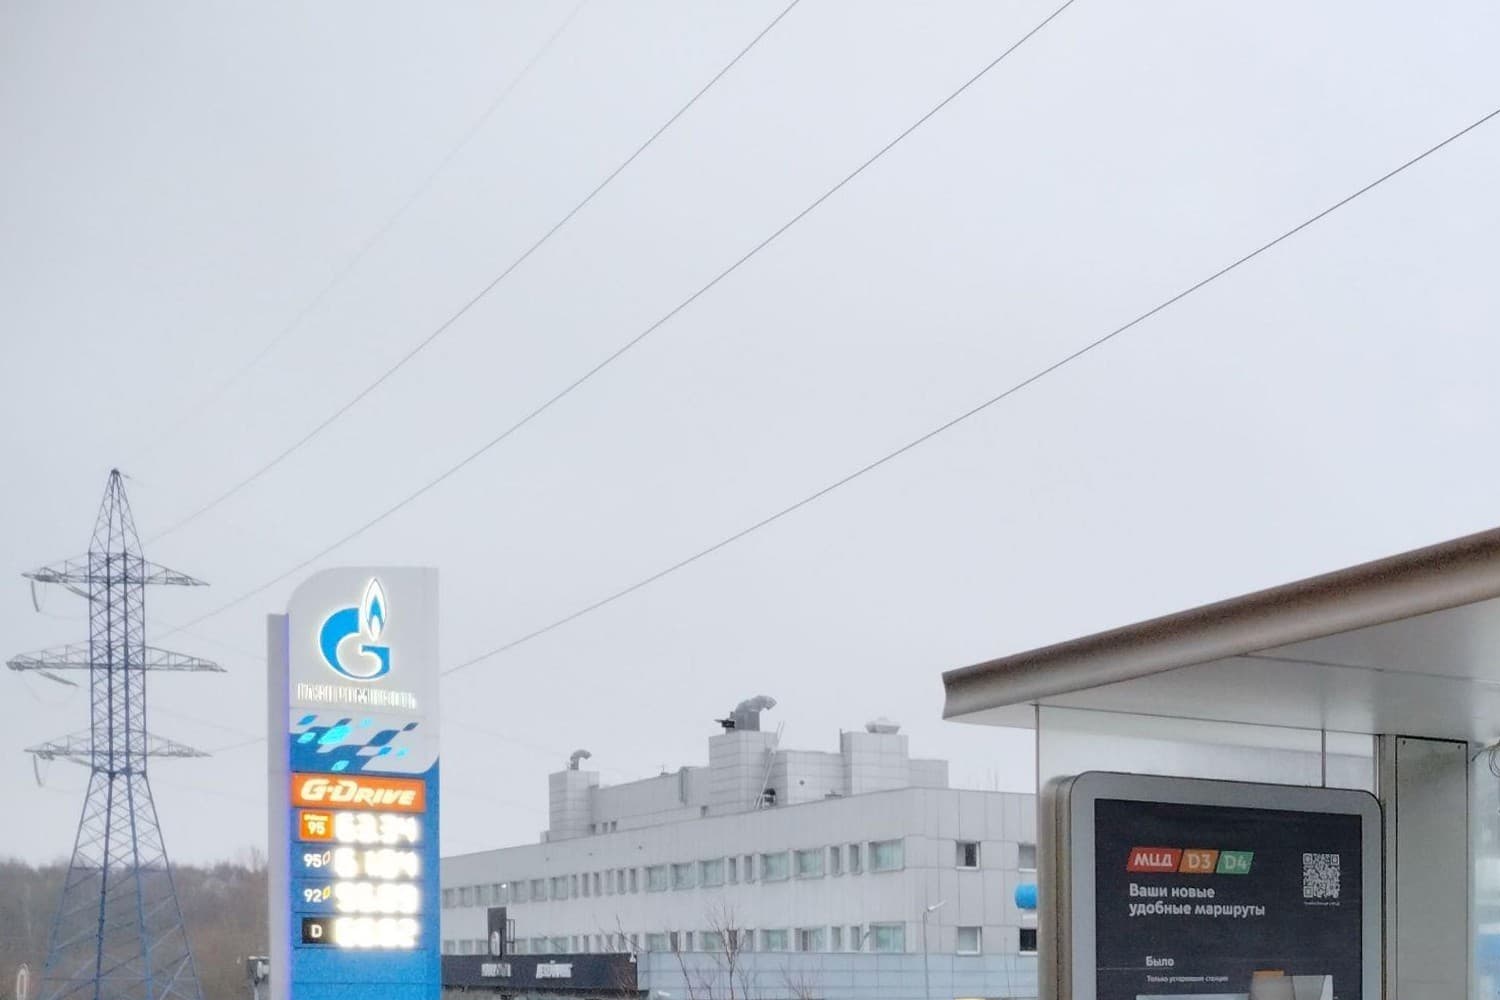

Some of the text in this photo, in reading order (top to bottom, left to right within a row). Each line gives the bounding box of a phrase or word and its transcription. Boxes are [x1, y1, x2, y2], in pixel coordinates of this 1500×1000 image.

[303, 853, 323, 868] 95
[1134, 853, 1248, 870] МЦД D3 D4
[303, 888, 323, 903] 92
[1129, 883, 1216, 898] Ваши новые
[1128, 901, 1266, 918] удобные маршруты
[311, 924, 323, 938] D
[1145, 955, 1175, 967] Было
